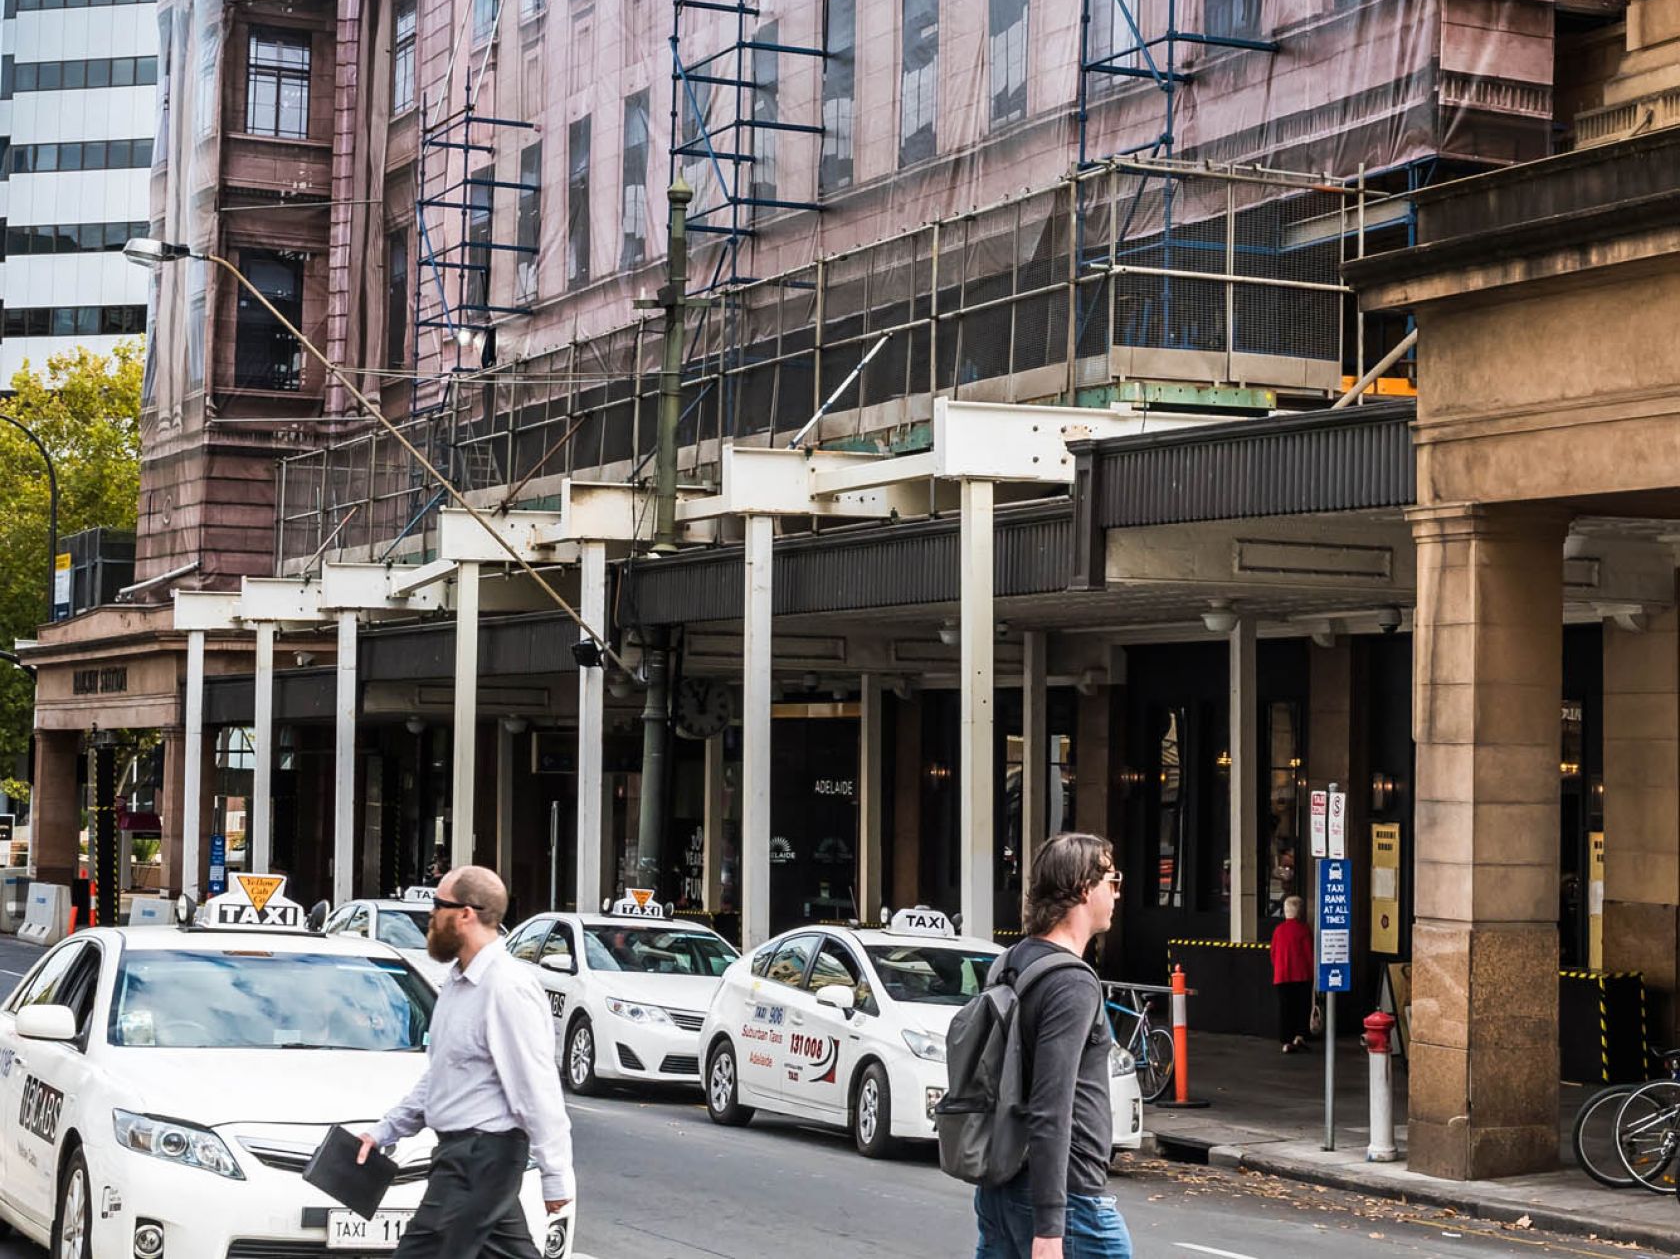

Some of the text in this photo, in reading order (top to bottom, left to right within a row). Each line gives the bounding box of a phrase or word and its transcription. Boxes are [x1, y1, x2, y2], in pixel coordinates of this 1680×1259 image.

[815, 780, 853, 795] ADELAIDE
[247, 878, 273, 886] Yellow
[415, 889, 435, 899] TA
[1326, 884, 1344, 893] TAXI
[1324, 894, 1346, 904] RANK
[221, 905, 295, 925] TAXI
[623, 905, 658, 917] TAXI
[1324, 906, 1349, 914] AT ALL
[905, 915, 945, 929] TAXI
[1325, 916, 1346, 924] TIMES
[742, 1024, 768, 1041] Suburban
[789, 1033, 823, 1060] 131 008
[336, 1222, 366, 1237] TAXI
